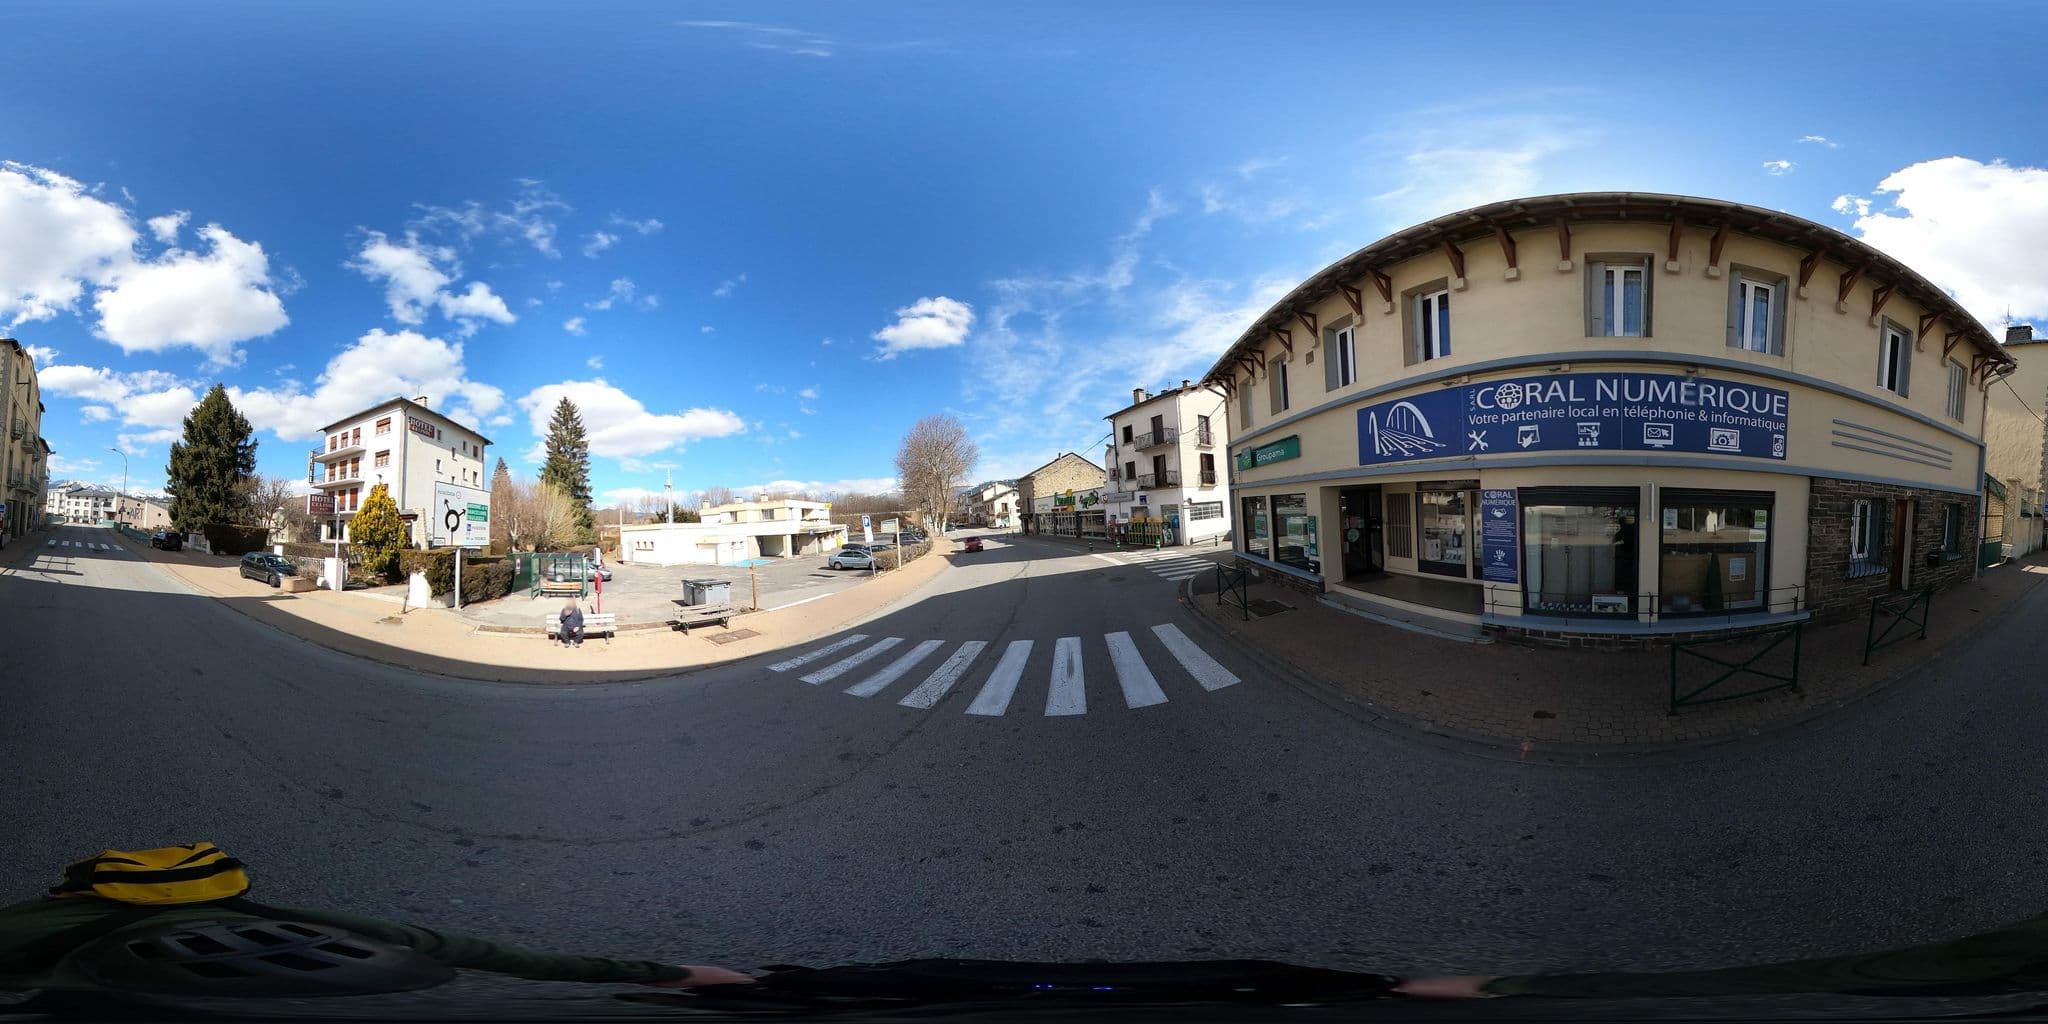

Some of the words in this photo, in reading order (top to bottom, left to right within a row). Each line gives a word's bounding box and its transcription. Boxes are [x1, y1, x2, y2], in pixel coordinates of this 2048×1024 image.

[1476, 379, 1585, 410] CORAL
[1468, 413, 1499, 425] Votre
[1501, 407, 1565, 424] partenaire
[1568, 405, 1599, 418] local
[1602, 407, 1619, 417] en
[1624, 405, 1696, 421] téléphonie
[1698, 409, 1708, 422] &
[1711, 411, 1786, 432] informatique
[1256, 449, 1285, 462] Groupama
[1484, 490, 1513, 498] CORAL
